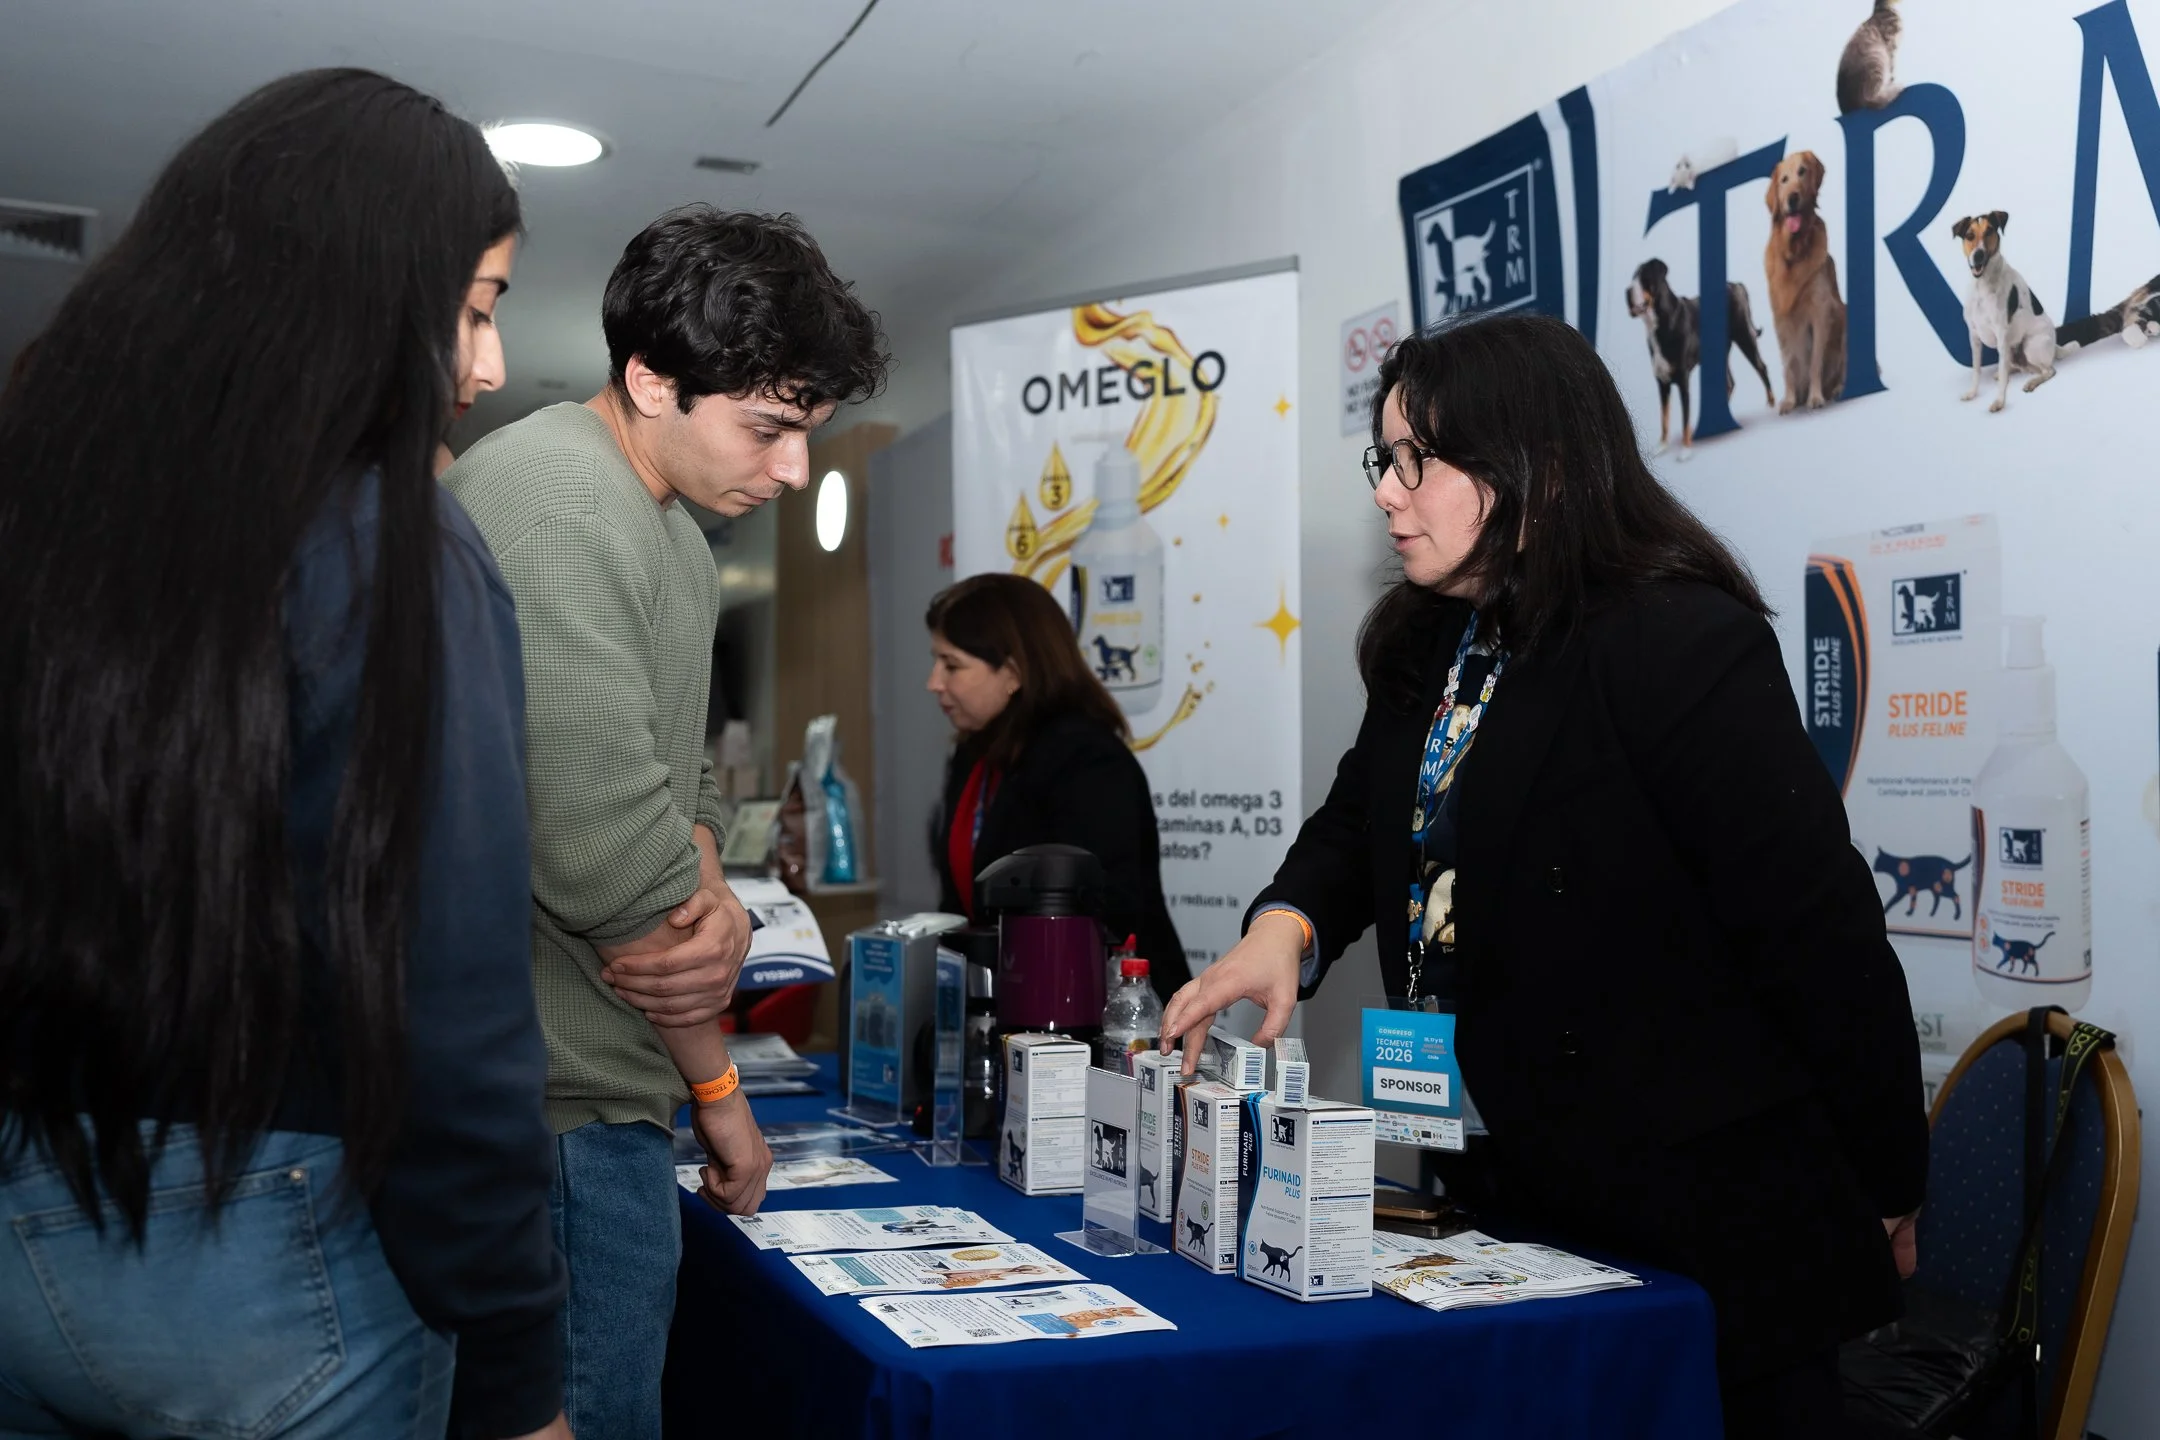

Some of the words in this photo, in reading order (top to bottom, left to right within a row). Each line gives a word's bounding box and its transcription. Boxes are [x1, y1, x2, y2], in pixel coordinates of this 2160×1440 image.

[1504, 188, 1525, 288] TRM
[1022, 350, 1227, 415] OMEGLO
[1051, 484, 1062, 506] 3
[1015, 533, 1028, 556] 6
[1831, 637, 1842, 688] FELINE
[1813, 637, 1831, 728] STRIDE
[1831, 690, 1842, 728] PLUS
[1888, 690, 1968, 718] STRIDE
[1888, 723, 1919, 738] PLUS
[1921, 721, 1967, 737] FELINE
[1422, 715, 1449, 776] TRM
[1167, 788, 1197, 808] del
[1201, 792, 1264, 813] omega
[1269, 790, 1283, 810] 3
[1157, 813, 1225, 834] aminas
[1230, 817, 1250, 838] A,
[1254, 816, 1283, 837] D3
[1160, 841, 1212, 860] atos?
[2001, 880, 2045, 897] STRIDE
[1375, 1037, 1414, 1048] TECMEVET
[1378, 1027, 1413, 1037] CONGRESO
[1375, 1046, 1413, 1063] 2026
[1380, 1078, 1442, 1095] SPONSOR
[1191, 1148, 1210, 1166] STRIDE
[1263, 1165, 1301, 1187] FURINAID
[1284, 1186, 1301, 1200] PLUS
